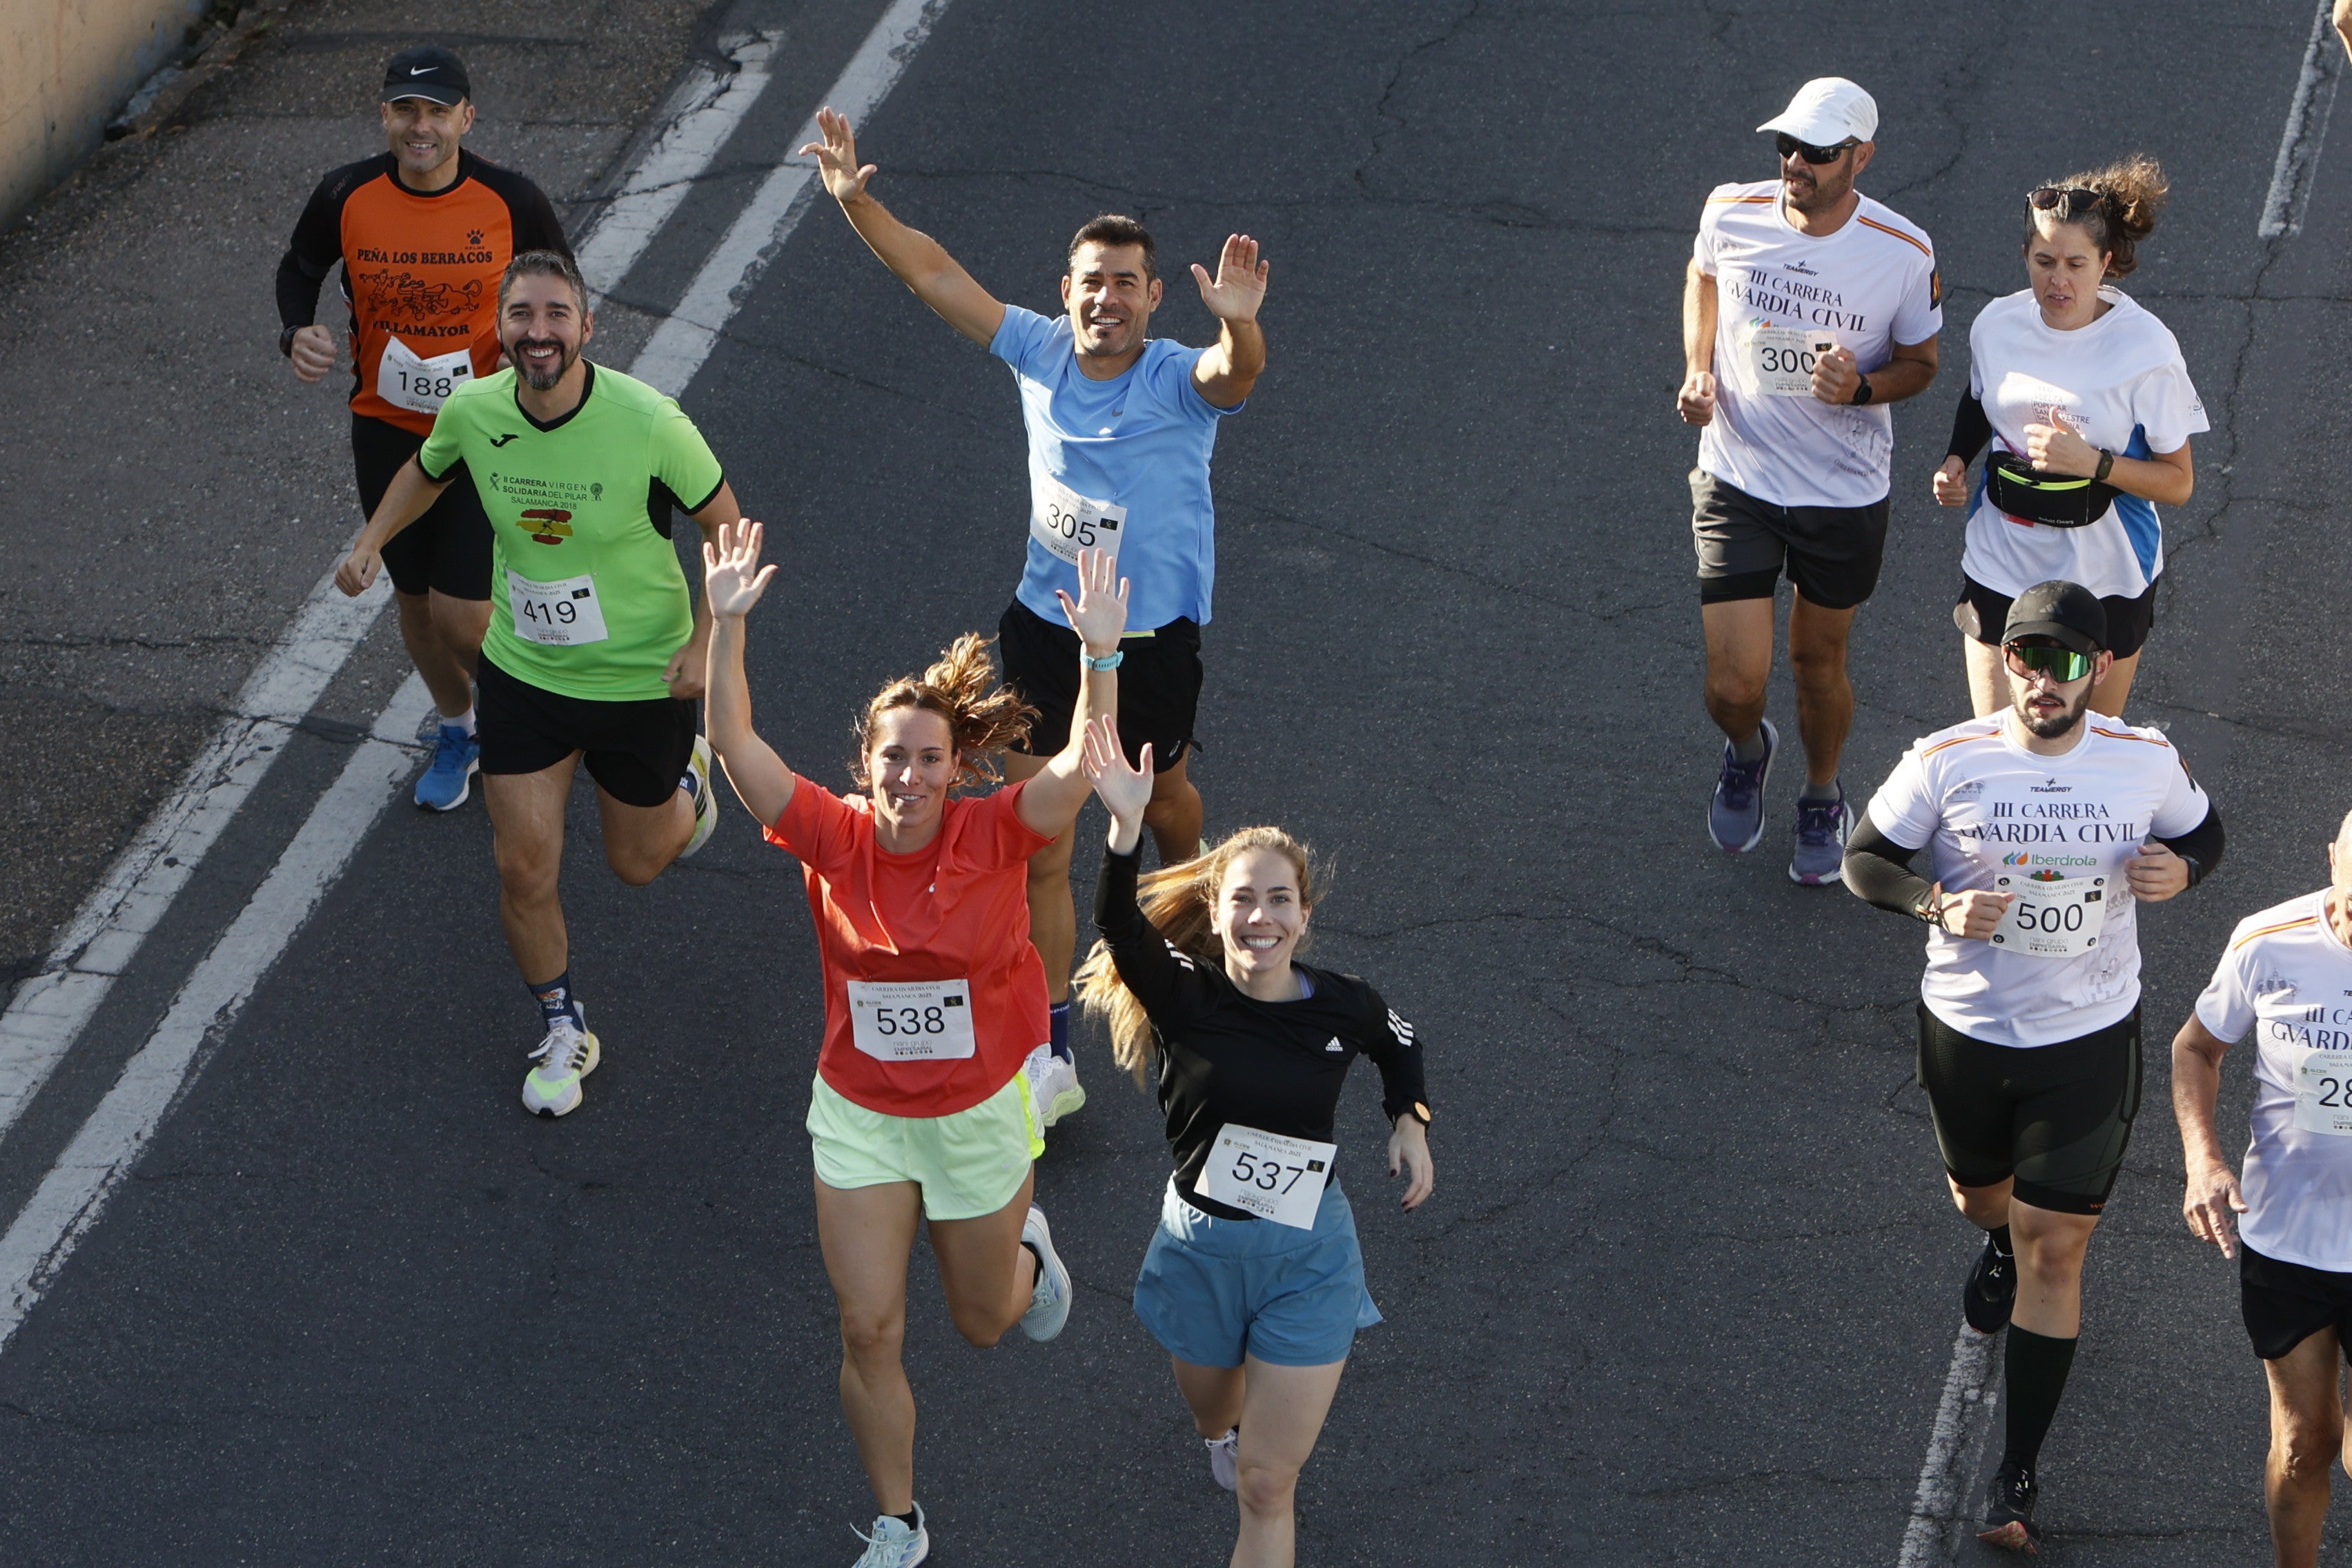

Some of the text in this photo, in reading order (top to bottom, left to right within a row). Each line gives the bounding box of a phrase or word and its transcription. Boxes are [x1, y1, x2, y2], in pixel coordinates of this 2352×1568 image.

[357, 247, 493, 264] PEÑA LOS BERRACOS
[1783, 263, 1819, 277] TEAMERGY
[1750, 269, 1843, 308] III CARRERA
[1725, 279, 1868, 333] GVARDIA CIVIL
[373, 320, 469, 337] VILLAMAYOR
[1761, 347, 1816, 375] 300
[398, 371, 452, 398] 188
[2033, 401, 2067, 412] POPUAR
[502, 486, 587, 501] SOLIDARIA DEL PILAR
[509, 477, 547, 488] CARRERA
[549, 481, 587, 491] VIRGEN
[511, 497, 578, 510] SALAMANCA 2018
[1047, 503, 1096, 547] 305
[524, 600, 576, 624] 419
[1993, 802, 2110, 820] III CARRERA
[1961, 822, 2137, 844] GVARDIA CIVIL
[2032, 854, 2097, 866] Iberdrola
[2017, 902, 2083, 933] 500
[877, 1006, 945, 1035] 538
[2272, 1021, 2352, 1050] GVARD
[1232, 1152, 1304, 1195] 537
